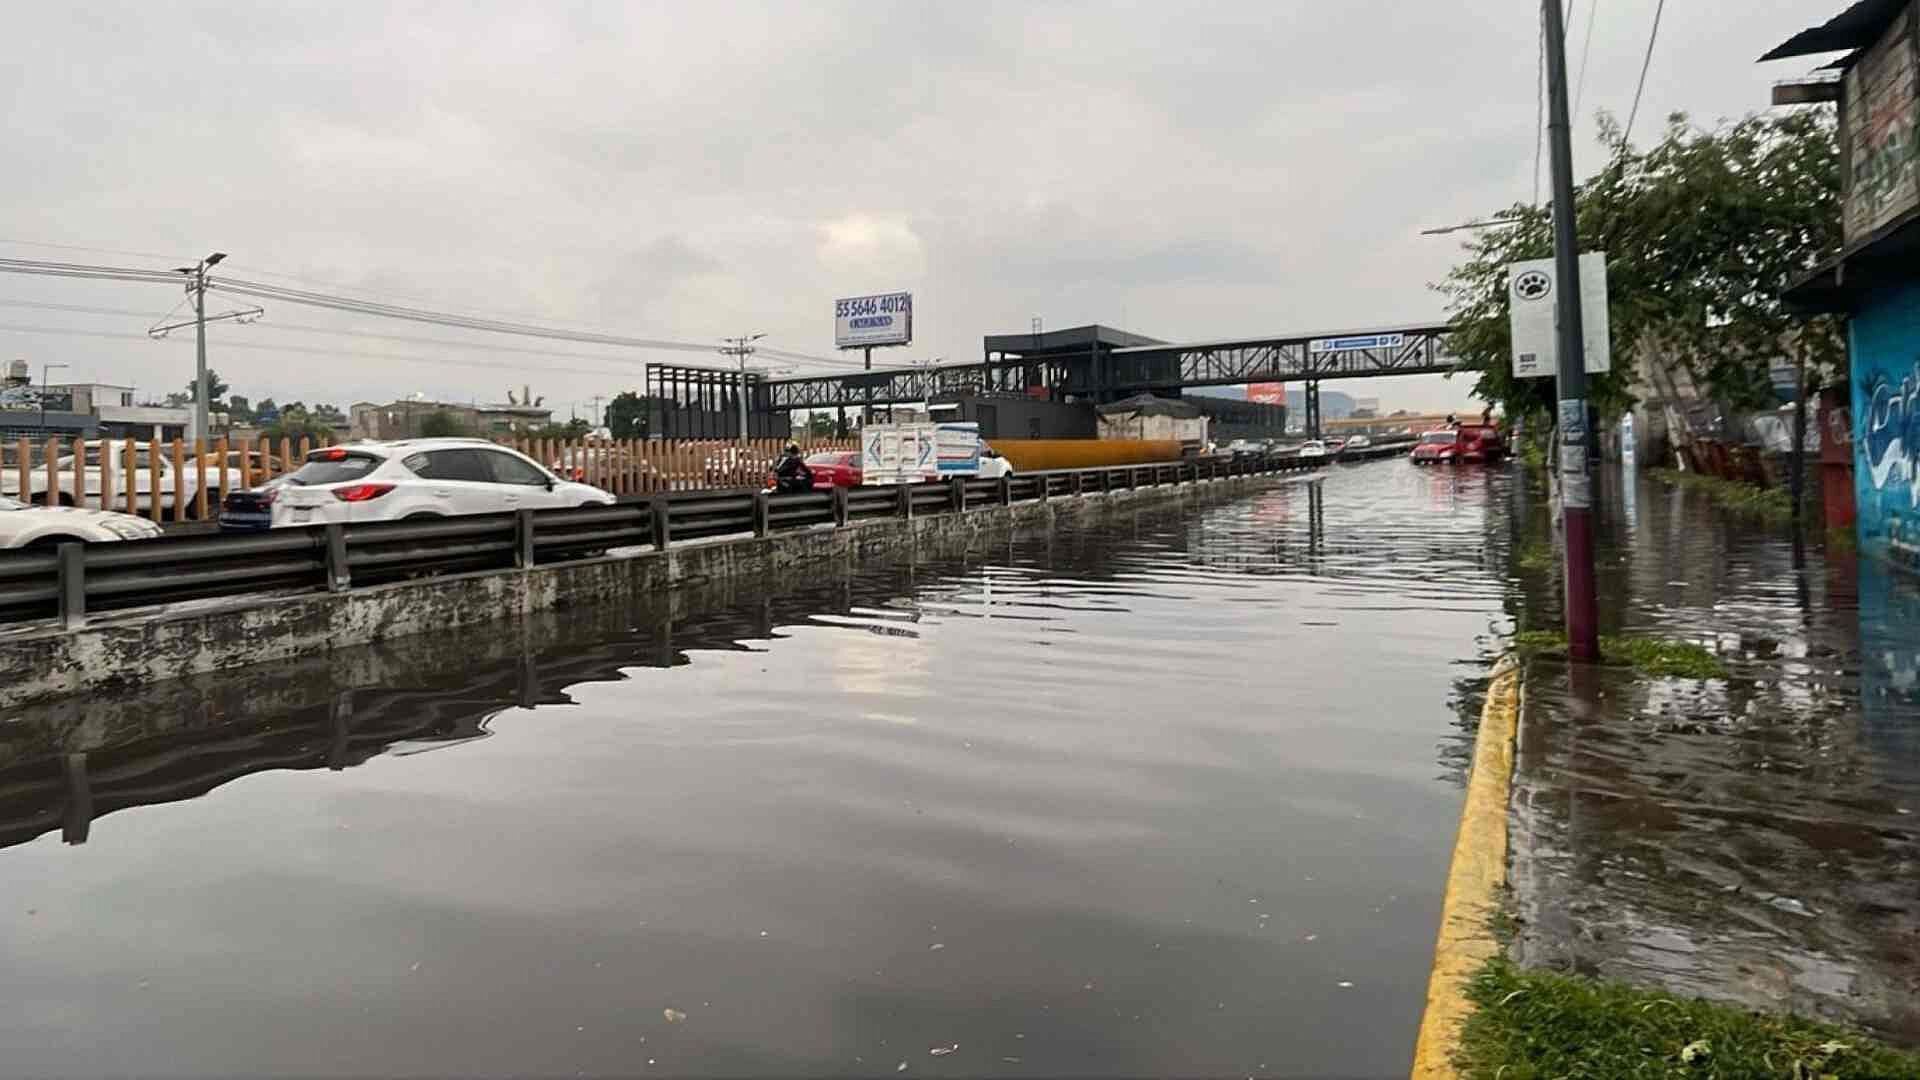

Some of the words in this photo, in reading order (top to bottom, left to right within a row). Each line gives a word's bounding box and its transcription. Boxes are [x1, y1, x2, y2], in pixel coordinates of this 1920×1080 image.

[836, 302, 849, 317] 55
[851, 299, 877, 316] 5646
[880, 296, 905, 313] 4012
